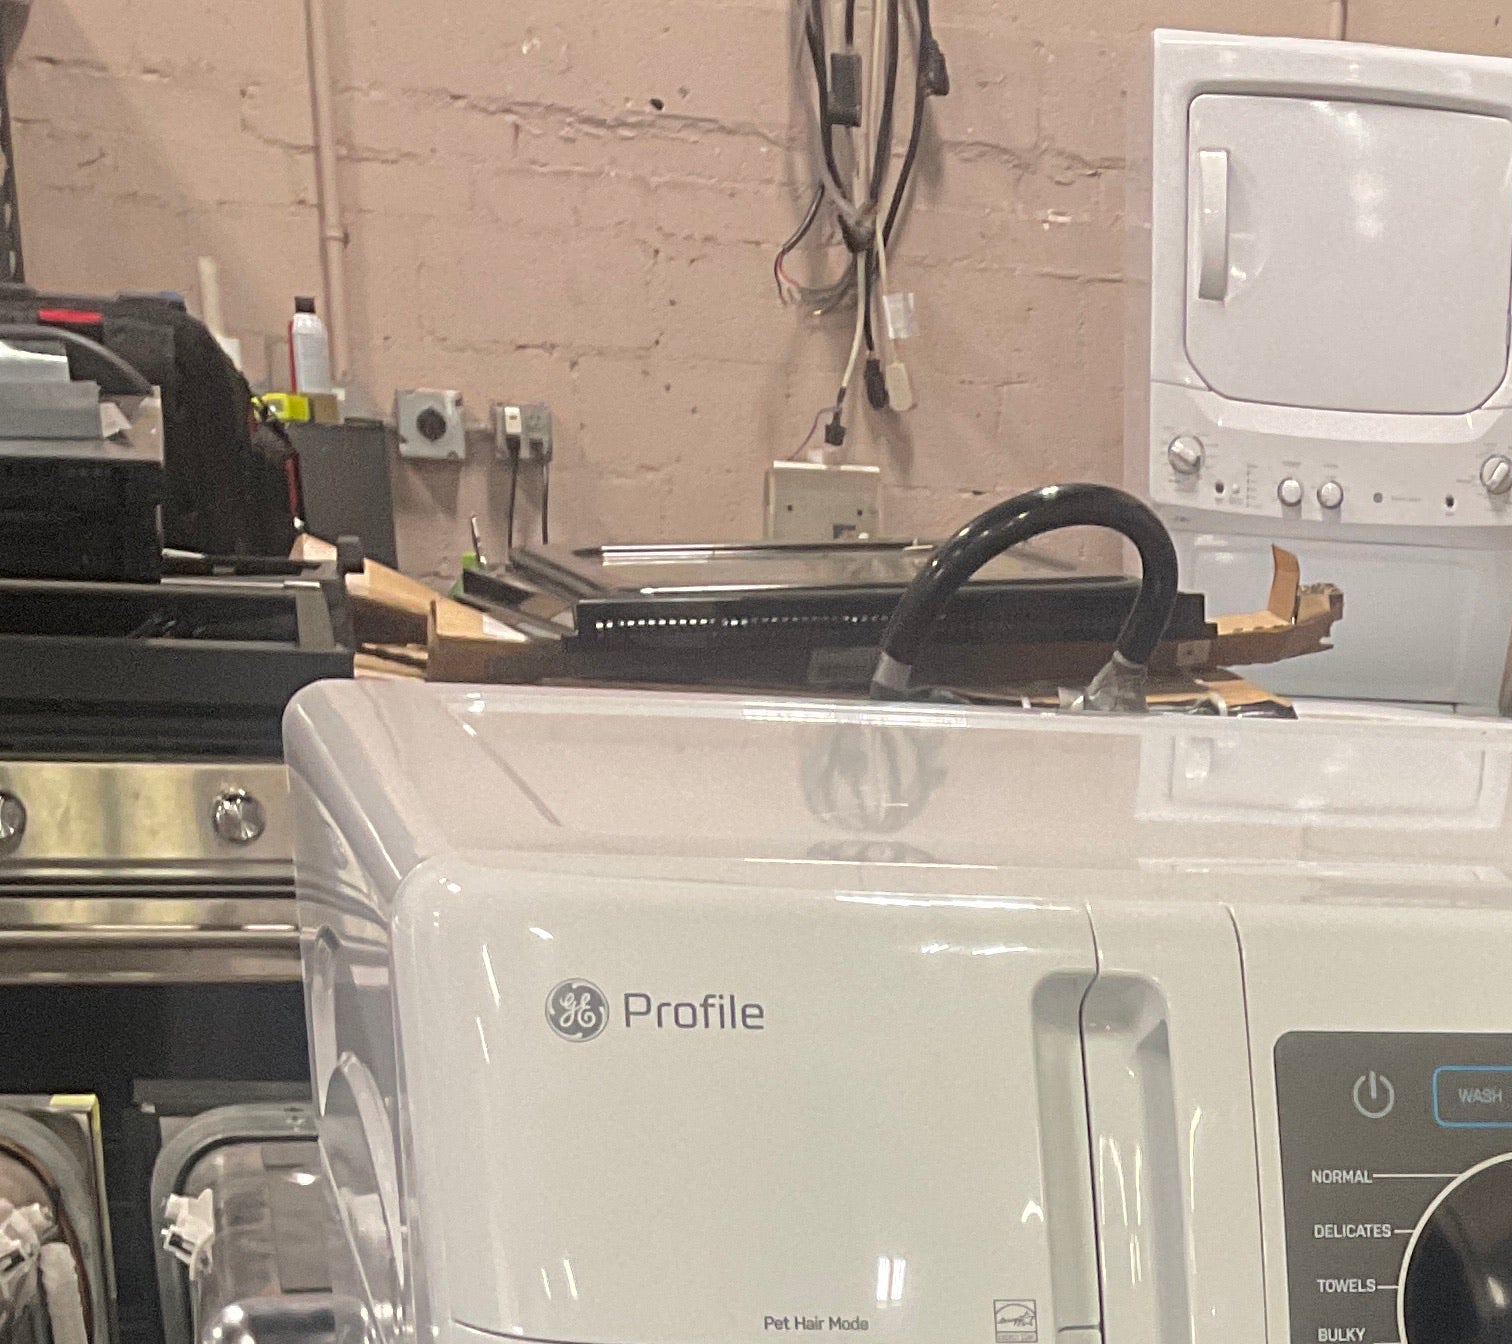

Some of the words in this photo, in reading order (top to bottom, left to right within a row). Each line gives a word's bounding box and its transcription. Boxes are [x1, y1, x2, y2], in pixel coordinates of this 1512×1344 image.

[623, 992, 764, 1030] Profile
[1458, 1086, 1503, 1104] WASH
[1311, 1169, 1373, 1184] NORMAL
[1314, 1223, 1392, 1239] DELICATES
[1317, 1278, 1377, 1293] TOWELS
[763, 1315, 791, 1331] Pet
[794, 1315, 824, 1331] Hair
[828, 1315, 870, 1331] Mode
[1317, 1327, 1366, 1342] BULKY
